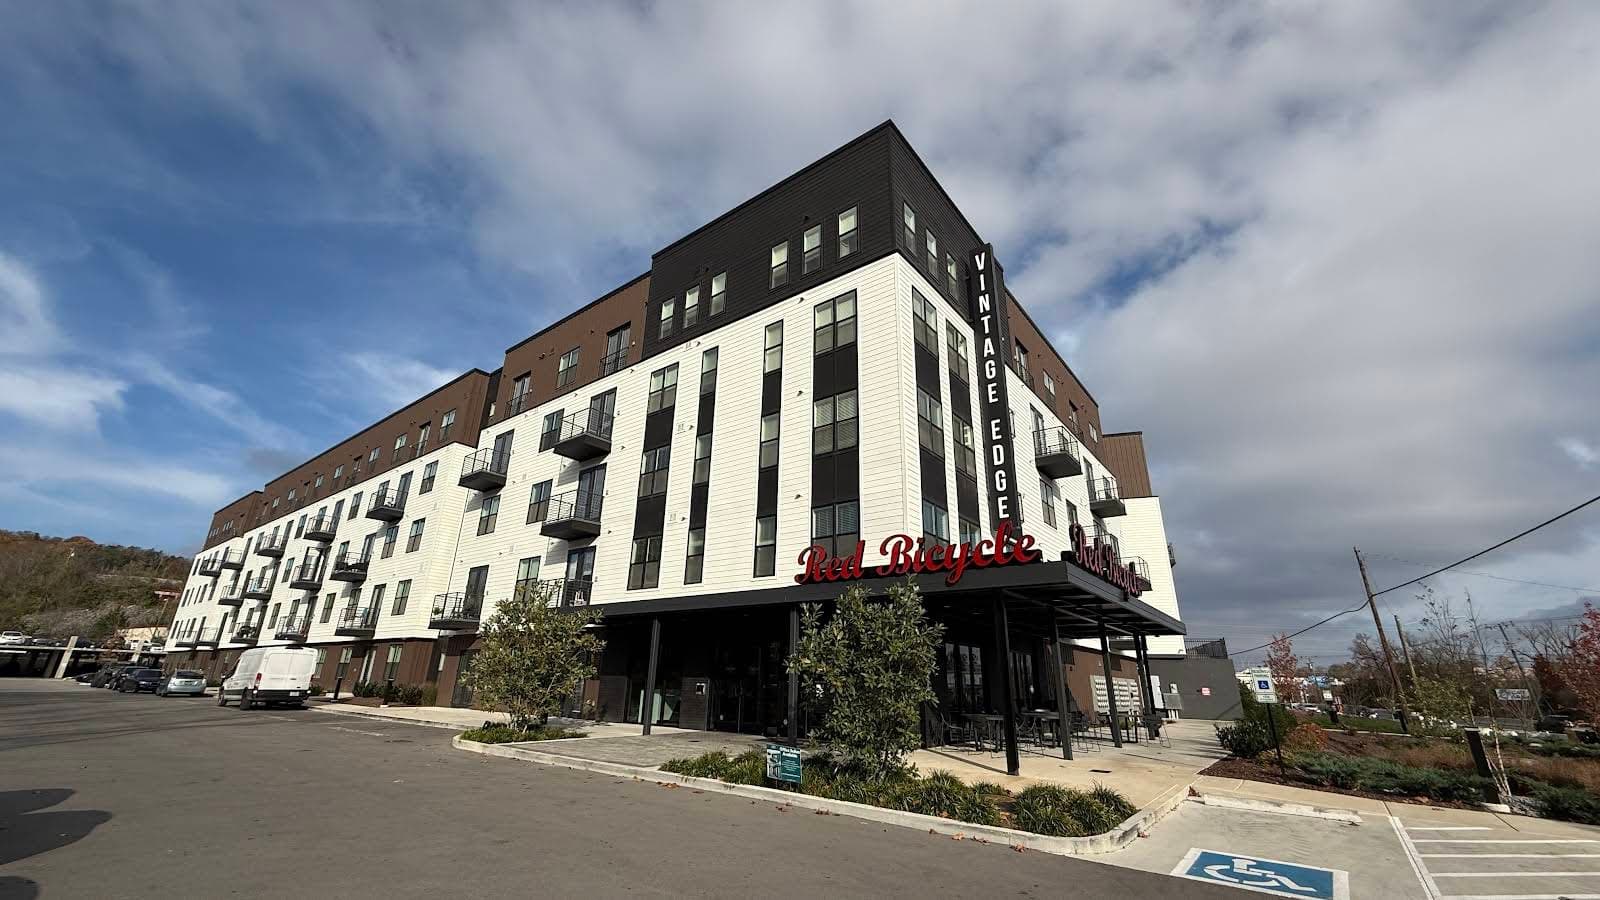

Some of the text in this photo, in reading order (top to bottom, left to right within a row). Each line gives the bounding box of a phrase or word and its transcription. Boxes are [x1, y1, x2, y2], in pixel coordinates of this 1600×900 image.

[974, 252, 1010, 519] VINTAGE EDGE
[794, 519, 1040, 587] Red Bicycle
